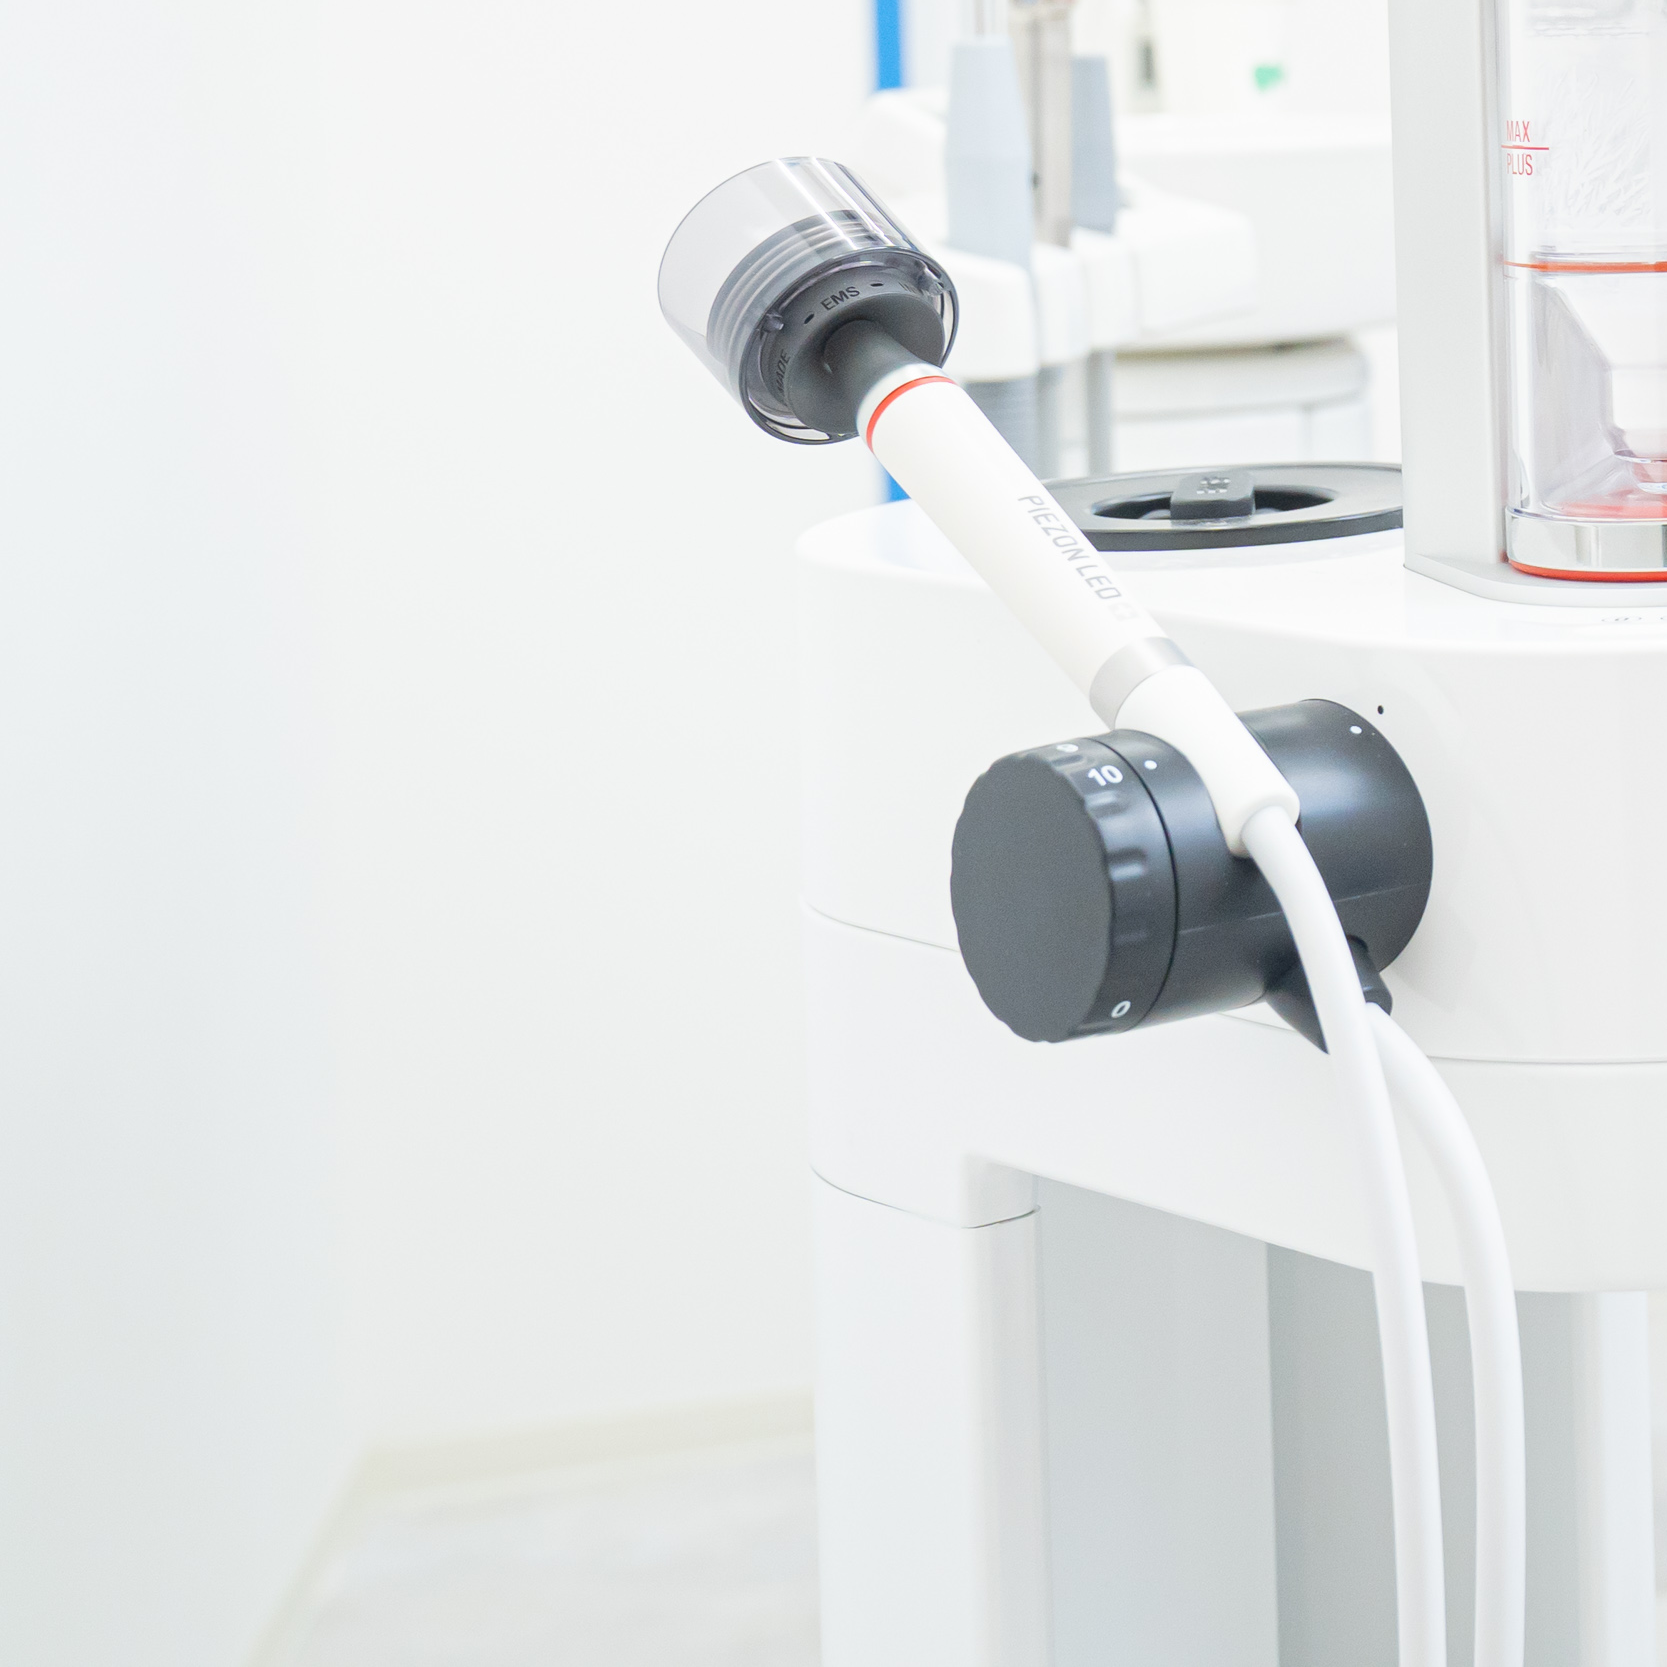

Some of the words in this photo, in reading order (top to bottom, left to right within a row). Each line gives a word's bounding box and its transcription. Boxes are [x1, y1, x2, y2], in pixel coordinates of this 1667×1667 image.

[1506, 120, 1530, 142] MAX
[1506, 152, 1533, 175] PLUS
[820, 286, 860, 311] EMS
[1017, 495, 1090, 562] PIEZON
[1075, 564, 1122, 600] LED
[1087, 764, 1124, 787] 10
[1110, 1000, 1131, 1019] 0
